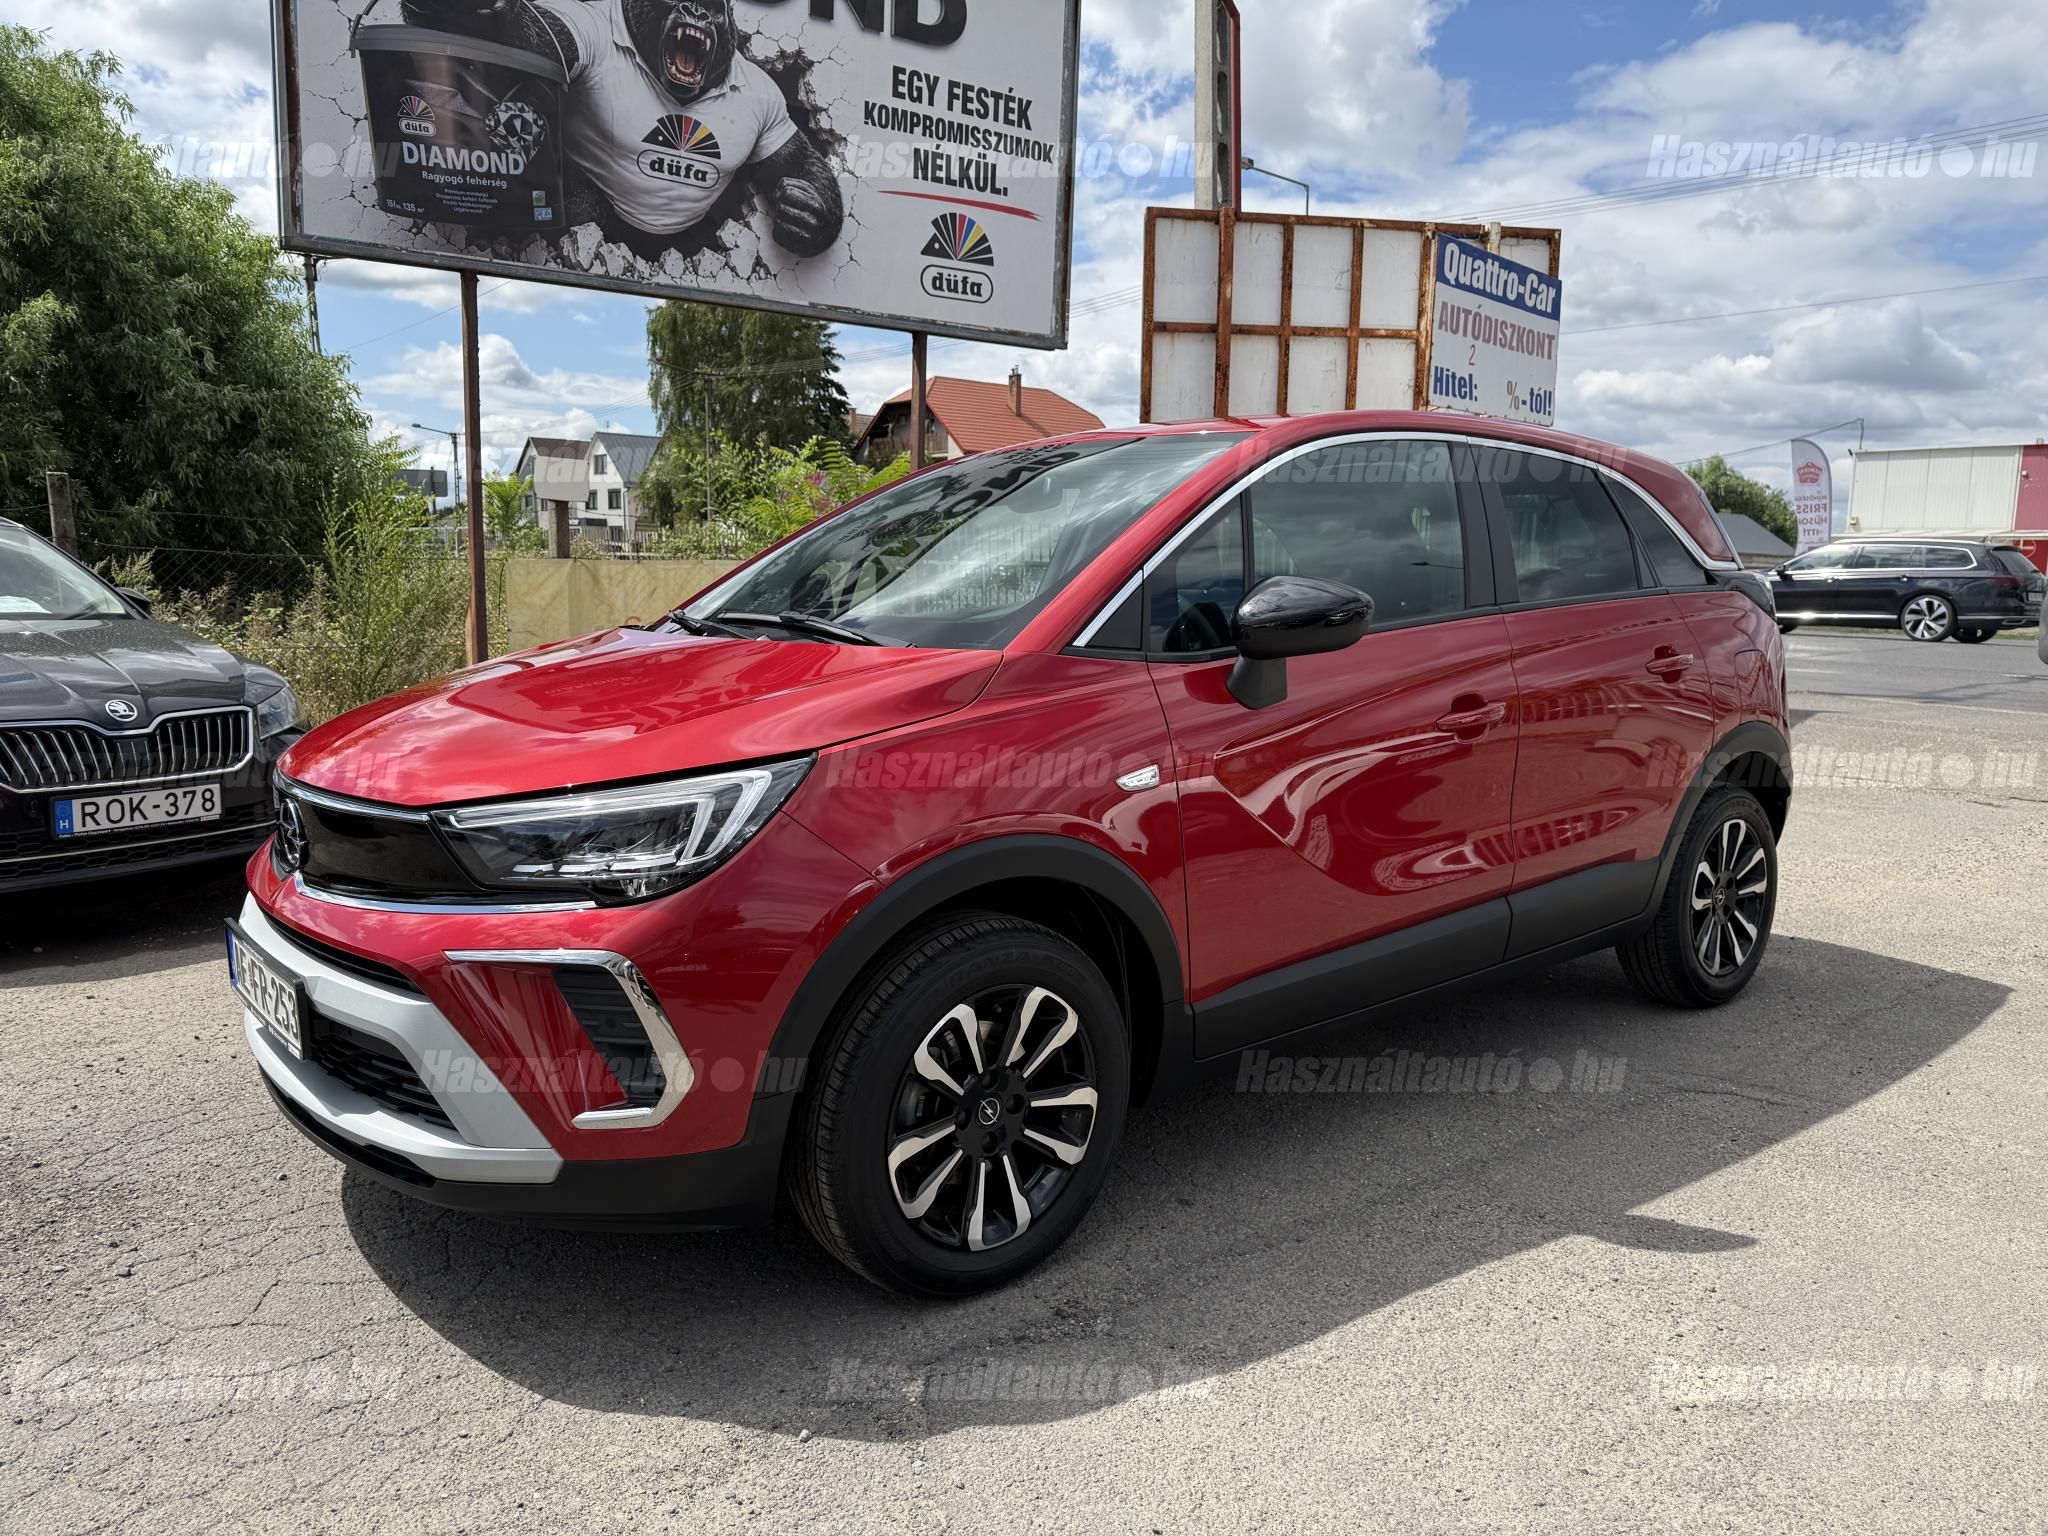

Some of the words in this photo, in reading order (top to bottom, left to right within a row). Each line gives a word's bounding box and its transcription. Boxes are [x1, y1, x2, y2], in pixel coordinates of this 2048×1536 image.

[891, 65, 940, 107] EGY
[946, 86, 1033, 131] FESTÉK
[404, 121, 430, 134] düfa
[863, 101, 1055, 164] KOMPROMISSZUMOK
[402, 141, 525, 175] DIAMOND
[648, 156, 709, 183] düfa
[912, 146, 1009, 197] NÉLKÜL.
[422, 171, 464, 185] Ragyogó
[466, 175, 507, 190] fehérség
[931, 272, 983, 298] düfa
[1443, 242, 1557, 313] Quattro-Car
[1437, 300, 1556, 361] AUTÓDISZKONT
[1432, 365, 1478, 402] Hitel:
[59, 818, 69, 830] H
[80, 788, 216, 828] ROK-378
